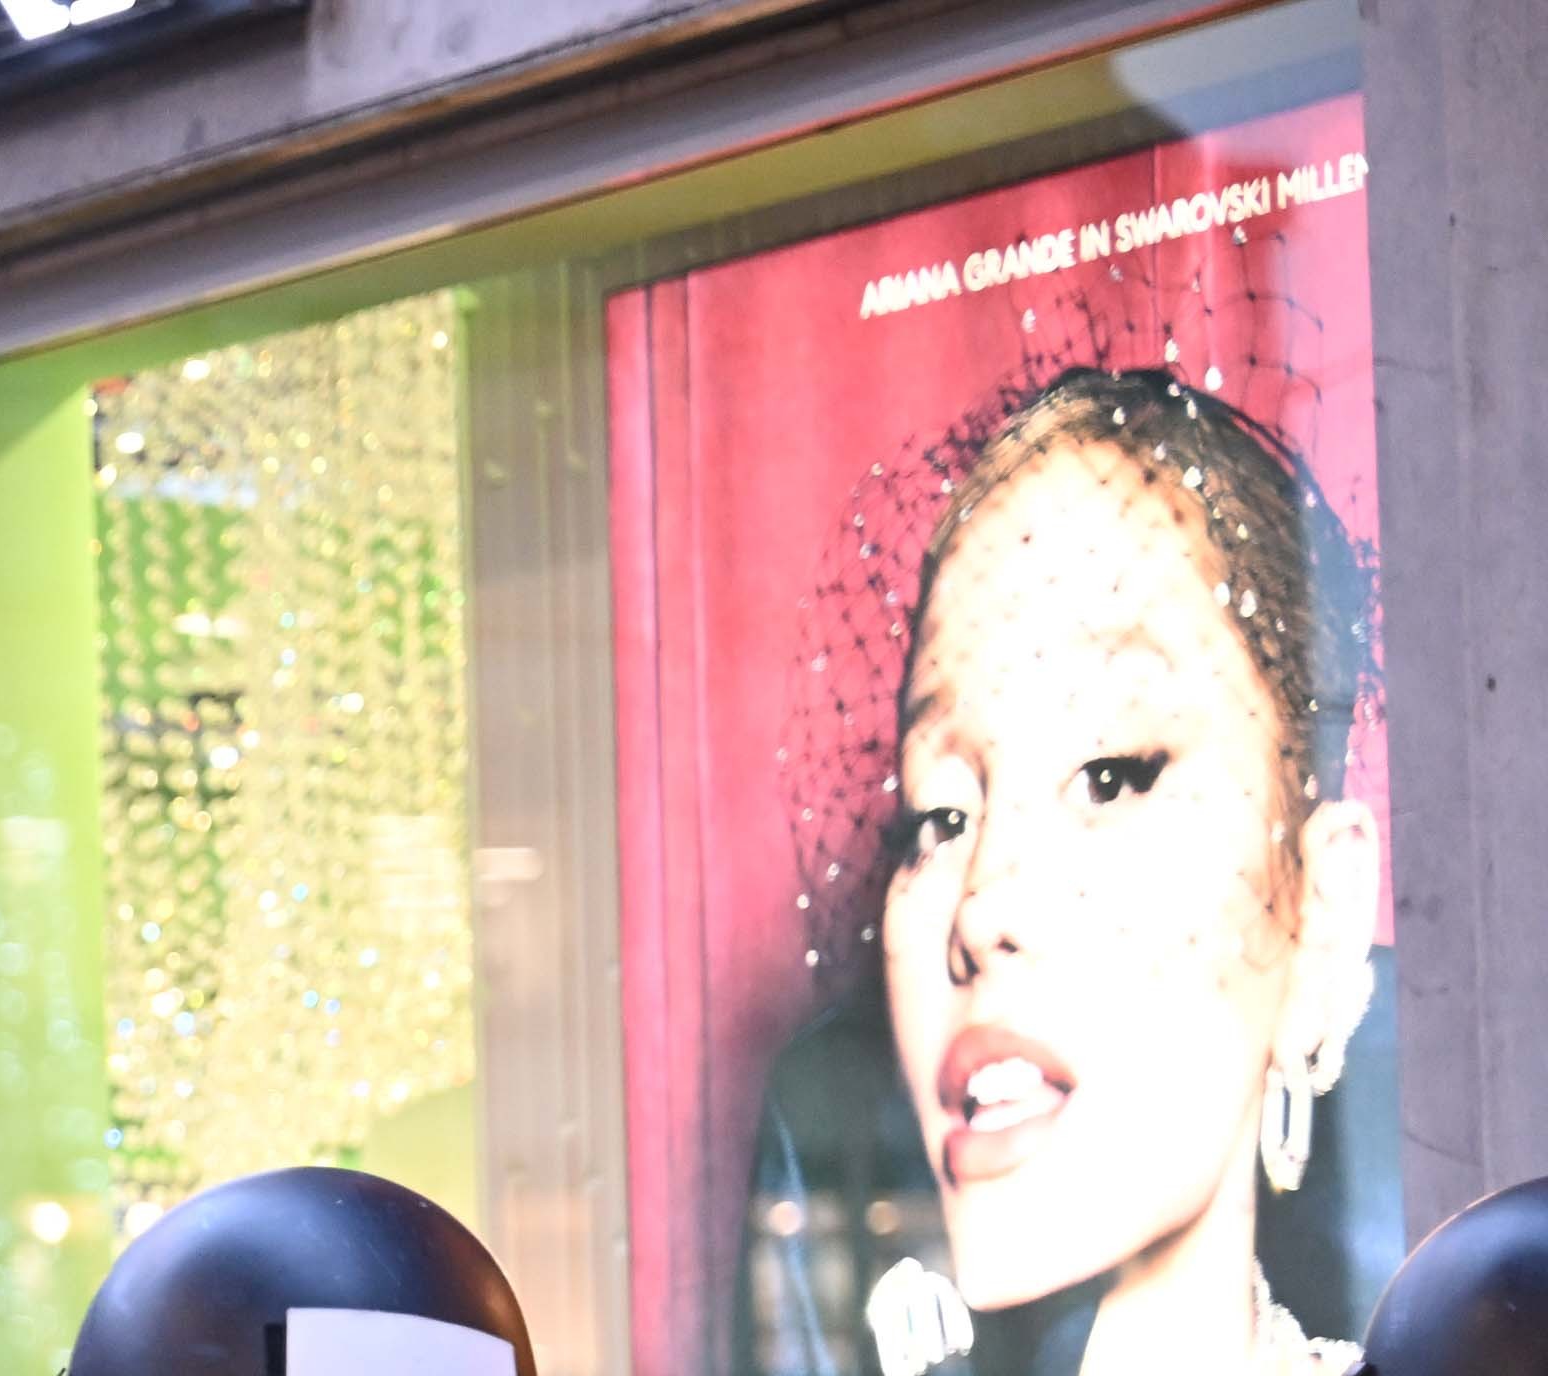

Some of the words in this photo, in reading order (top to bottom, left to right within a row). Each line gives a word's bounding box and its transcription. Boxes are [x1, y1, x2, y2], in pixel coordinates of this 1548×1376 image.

[859, 261, 961, 319] ARIANA
[962, 227, 1076, 293] GRANDE
[1079, 219, 1112, 261] IN
[1113, 174, 1272, 254] SWAROVSKI
